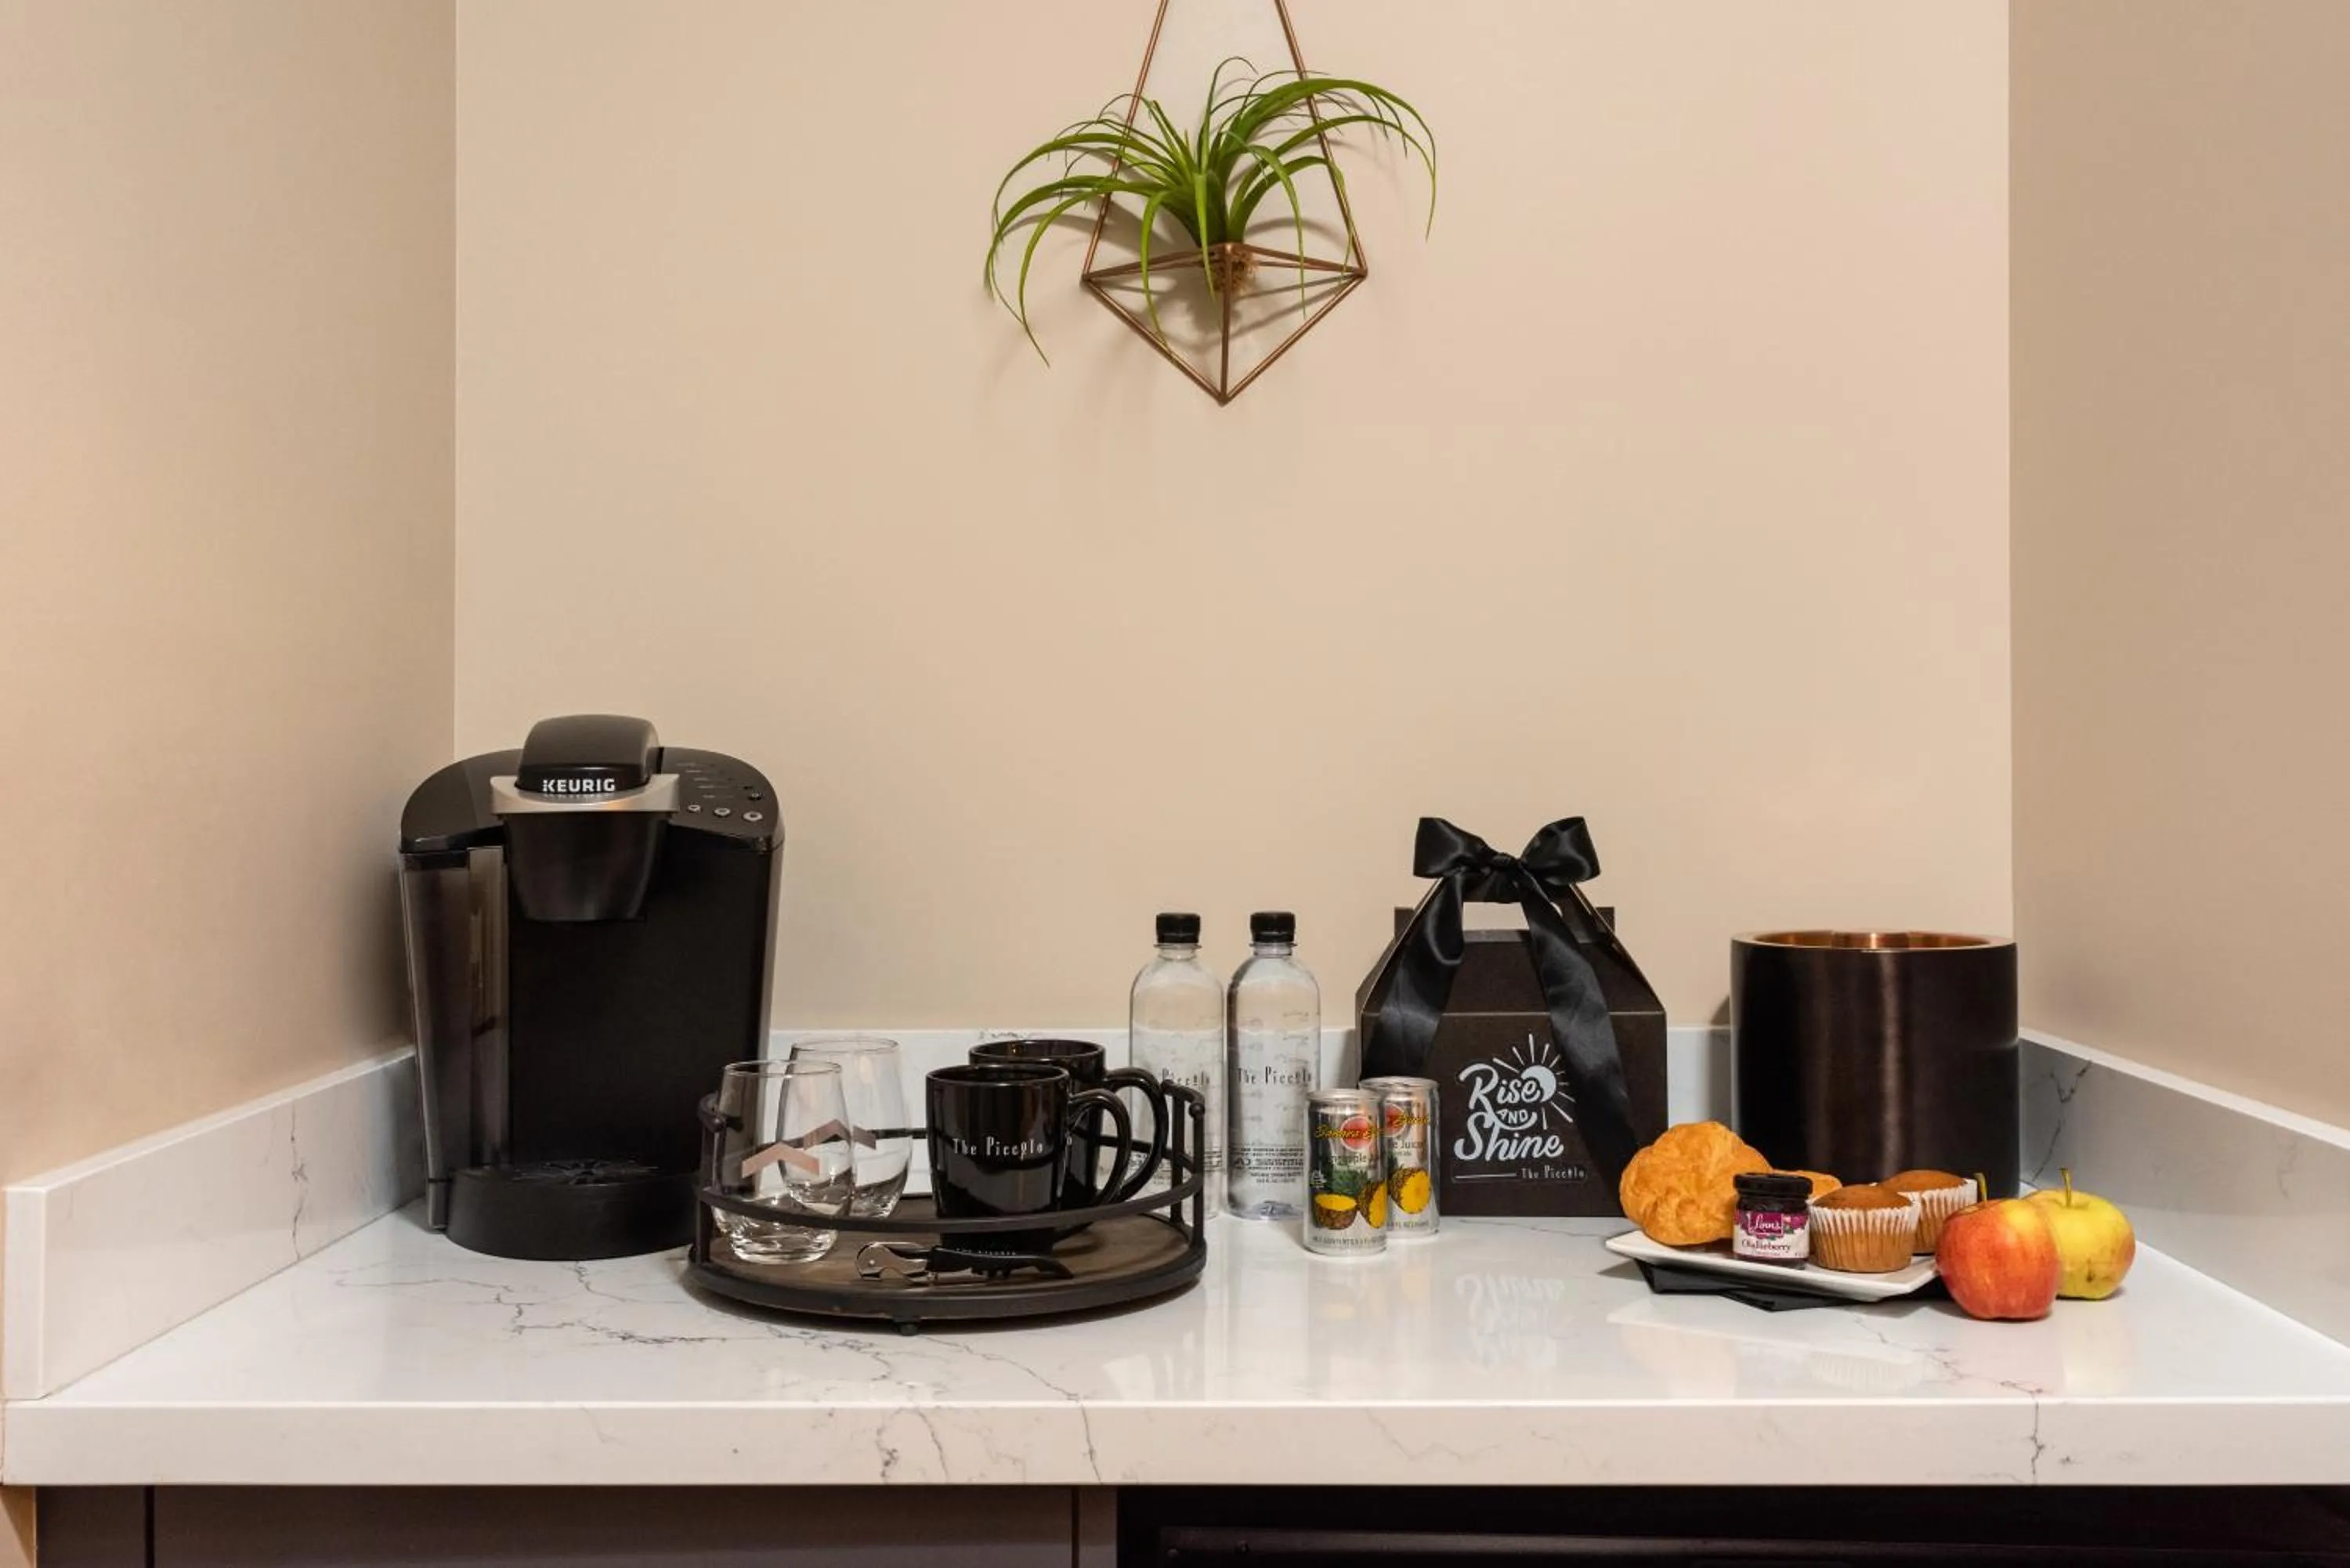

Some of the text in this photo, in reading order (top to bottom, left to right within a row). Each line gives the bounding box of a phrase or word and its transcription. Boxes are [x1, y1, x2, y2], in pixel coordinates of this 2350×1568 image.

[543, 779, 615, 792] KEURIG
[1459, 1063, 1541, 1131] Rise
[1497, 1108, 1528, 1124] AND
[1453, 1111, 1564, 1162] Shine
[953, 1138, 977, 1155] The
